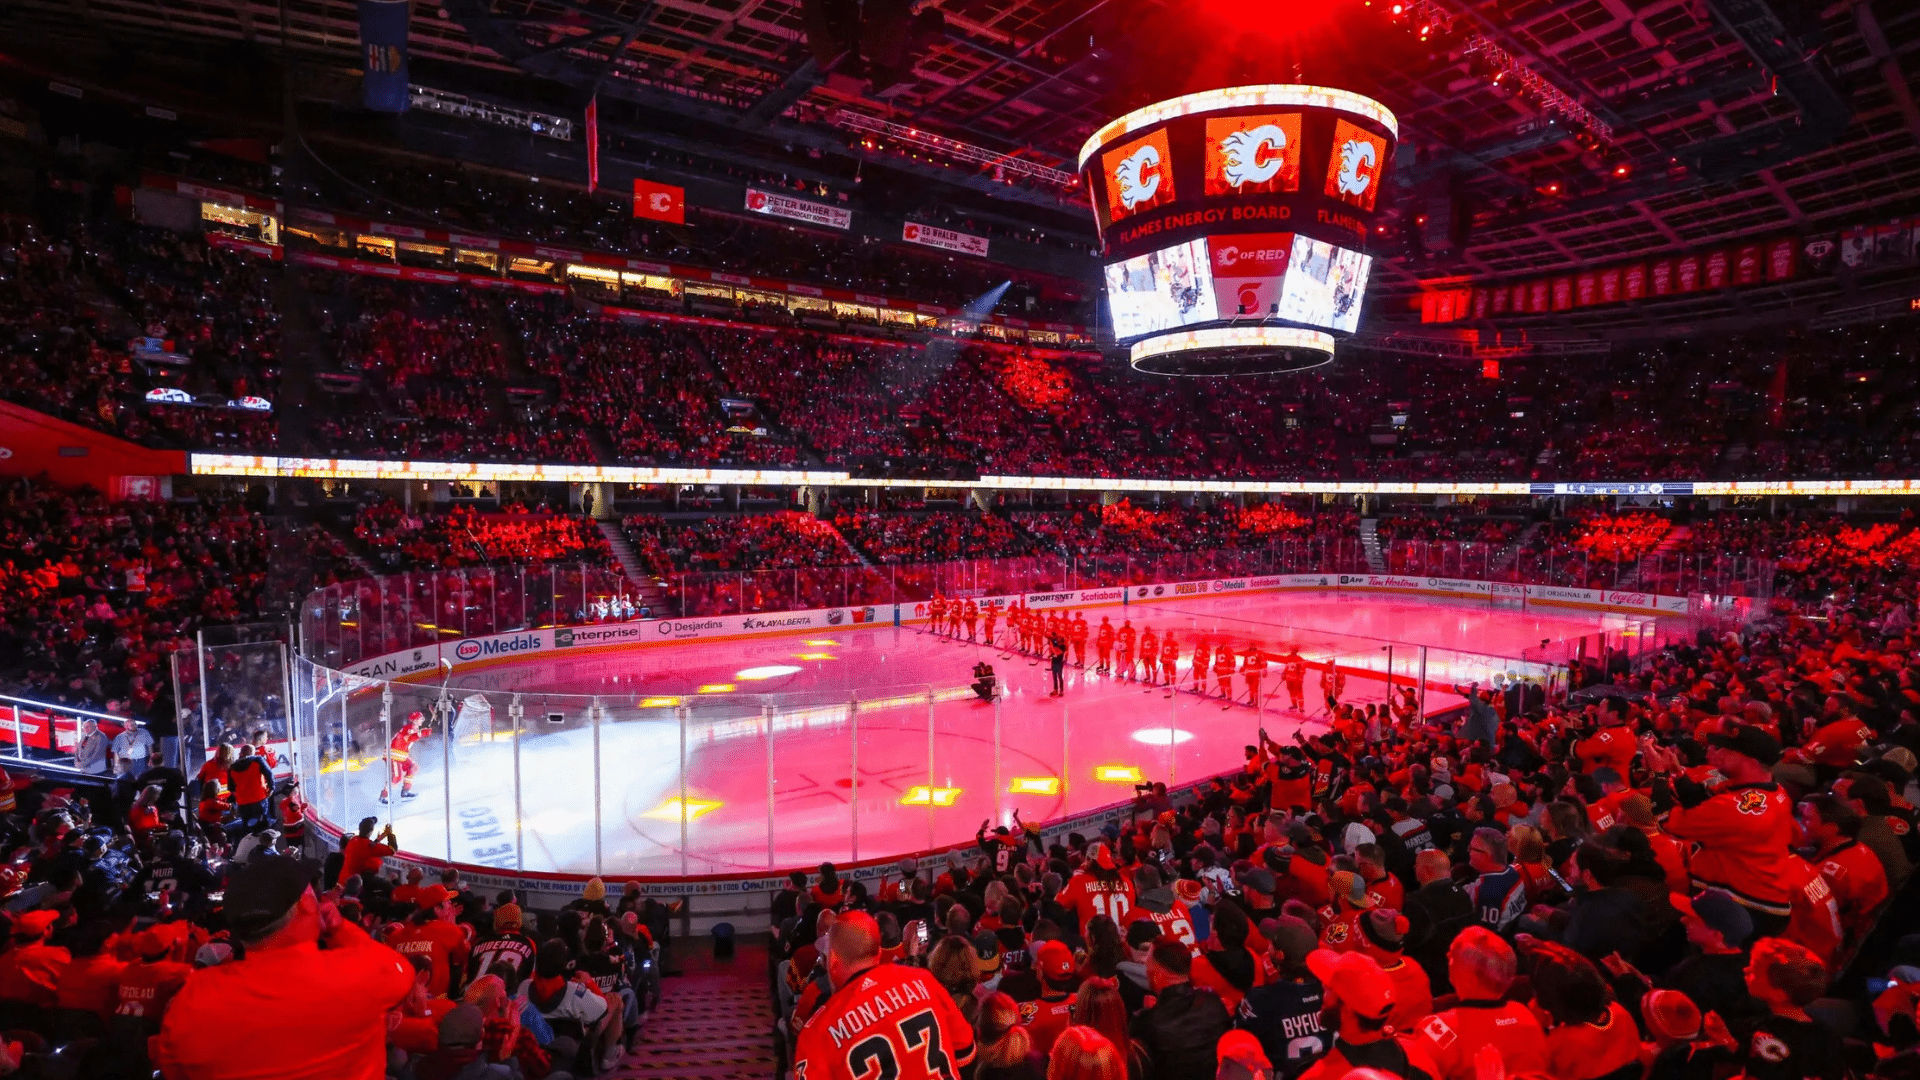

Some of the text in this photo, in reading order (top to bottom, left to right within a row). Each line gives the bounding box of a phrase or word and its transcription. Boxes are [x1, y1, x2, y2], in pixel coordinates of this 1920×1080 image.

[768, 196, 830, 216] PETER MAHER
[1120, 206, 1291, 244] FLAMES ENERGY BOARD
[922, 226, 958, 241] ED WHALEN
[1240, 251, 1255, 260] OF
[1255, 249, 1286, 261] RED
[1175, 582, 1197, 594] PIZZA
[1224, 580, 1246, 589] Medals
[1250, 578, 1281, 588] Scotiabank
[1368, 576, 1419, 588] Tim Hortons
[1476, 583, 1532, 595] NISSAN
[1547, 590, 1592, 600] ORIGINAL 16
[1029, 593, 1075, 603] SPORTSNET
[1080, 591, 1122, 602] Scotiabank
[1609, 592, 1646, 606] Coca-Cola
[674, 620, 723, 633] Desjardins
[756, 617, 811, 629] PLAYALBERTA
[559, 628, 638, 642] enterprise
[484, 635, 541, 656] Medals
[152, 867, 174, 878] MUIR
[651, 885, 661, 893] THE
[663, 885, 685, 893] POWER
[686, 884, 694, 893] OF
[723, 883, 739, 892] FOOD
[765, 880, 777, 888] THE
[1092, 892, 1129, 927] 10
[1481, 905, 1499, 924] 10
[472, 939, 533, 960] HUBERDEAU
[827, 979, 932, 1050] MONAHAN
